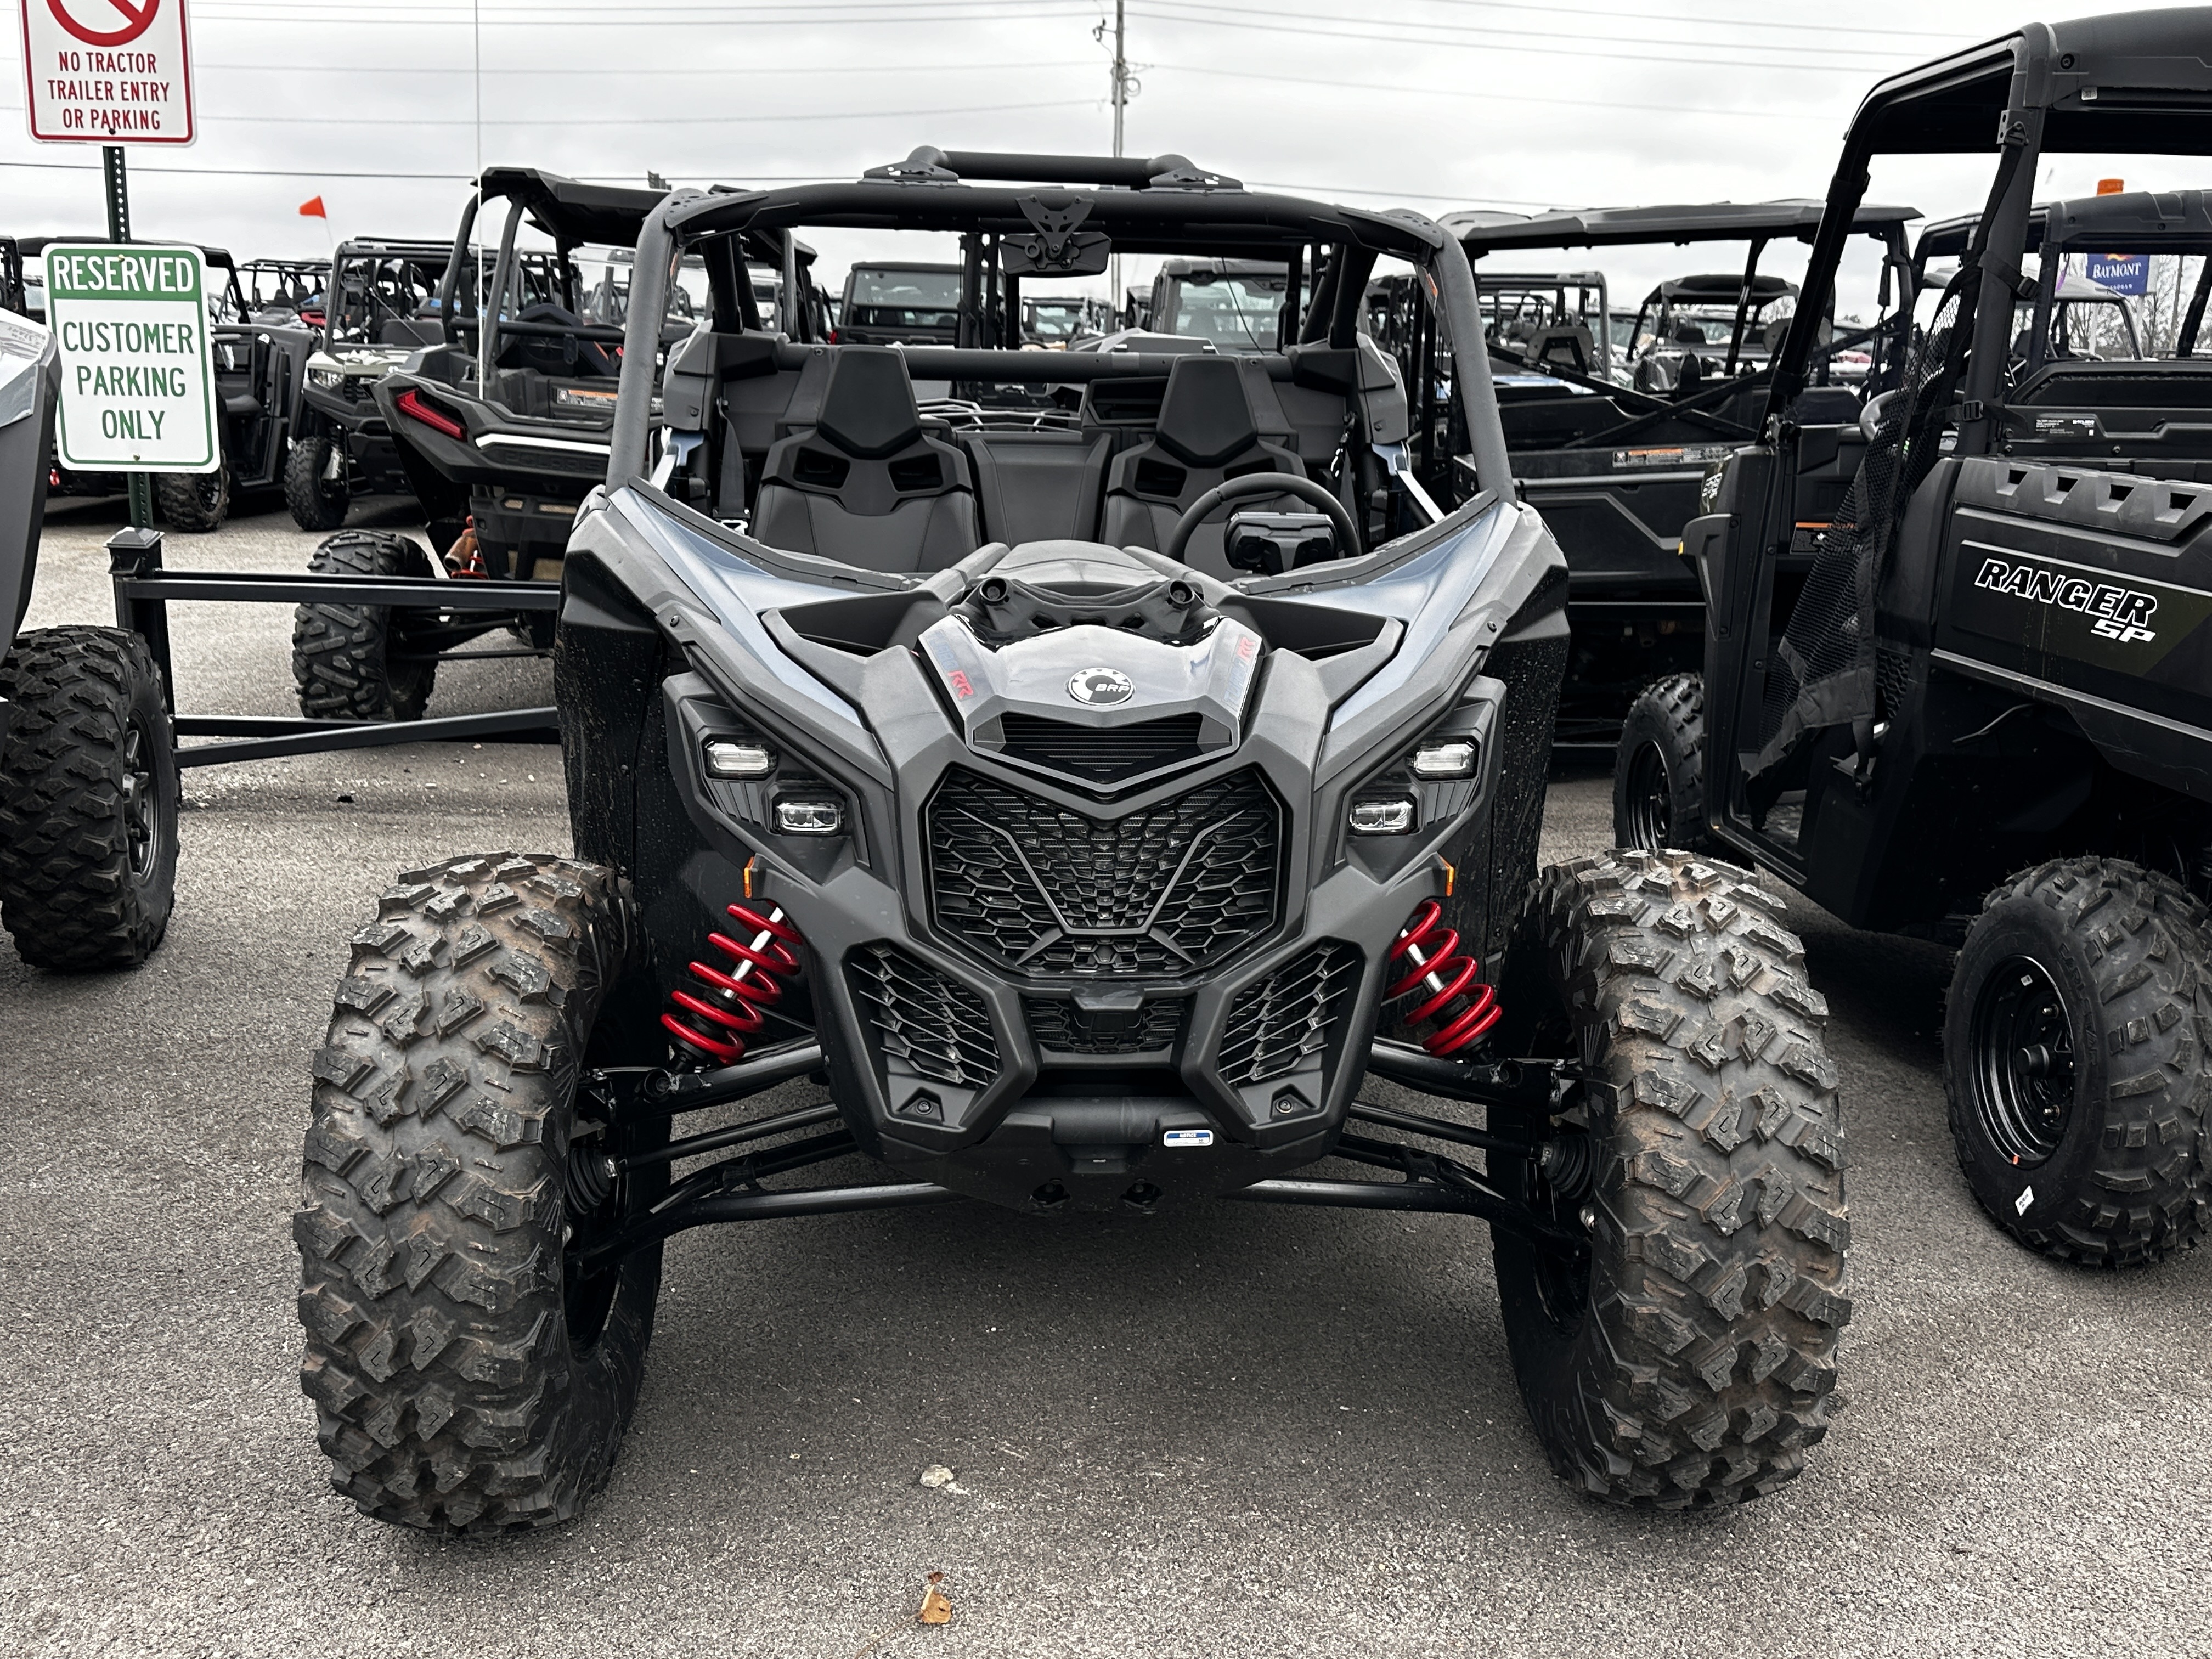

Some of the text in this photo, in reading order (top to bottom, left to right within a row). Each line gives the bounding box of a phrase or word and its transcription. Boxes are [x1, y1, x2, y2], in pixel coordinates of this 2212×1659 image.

[59, 52, 157, 74] NO TRACTOR
[47, 80, 170, 102] TRAILER ENTRY
[63, 108, 160, 130] OR PARKING
[53, 255, 194, 292] RESERVED
[2092, 262, 2142, 279] BAYMONT
[63, 321, 194, 354] CUSTOMER
[76, 365, 185, 397] PARKING
[102, 409, 165, 440] ONLY
[1974, 558, 2158, 628] RANGER
[2090, 618, 2157, 643] SP
[1237, 636, 1256, 663] RR
[947, 669, 974, 700] RR
[1095, 684, 1130, 693] BRP
